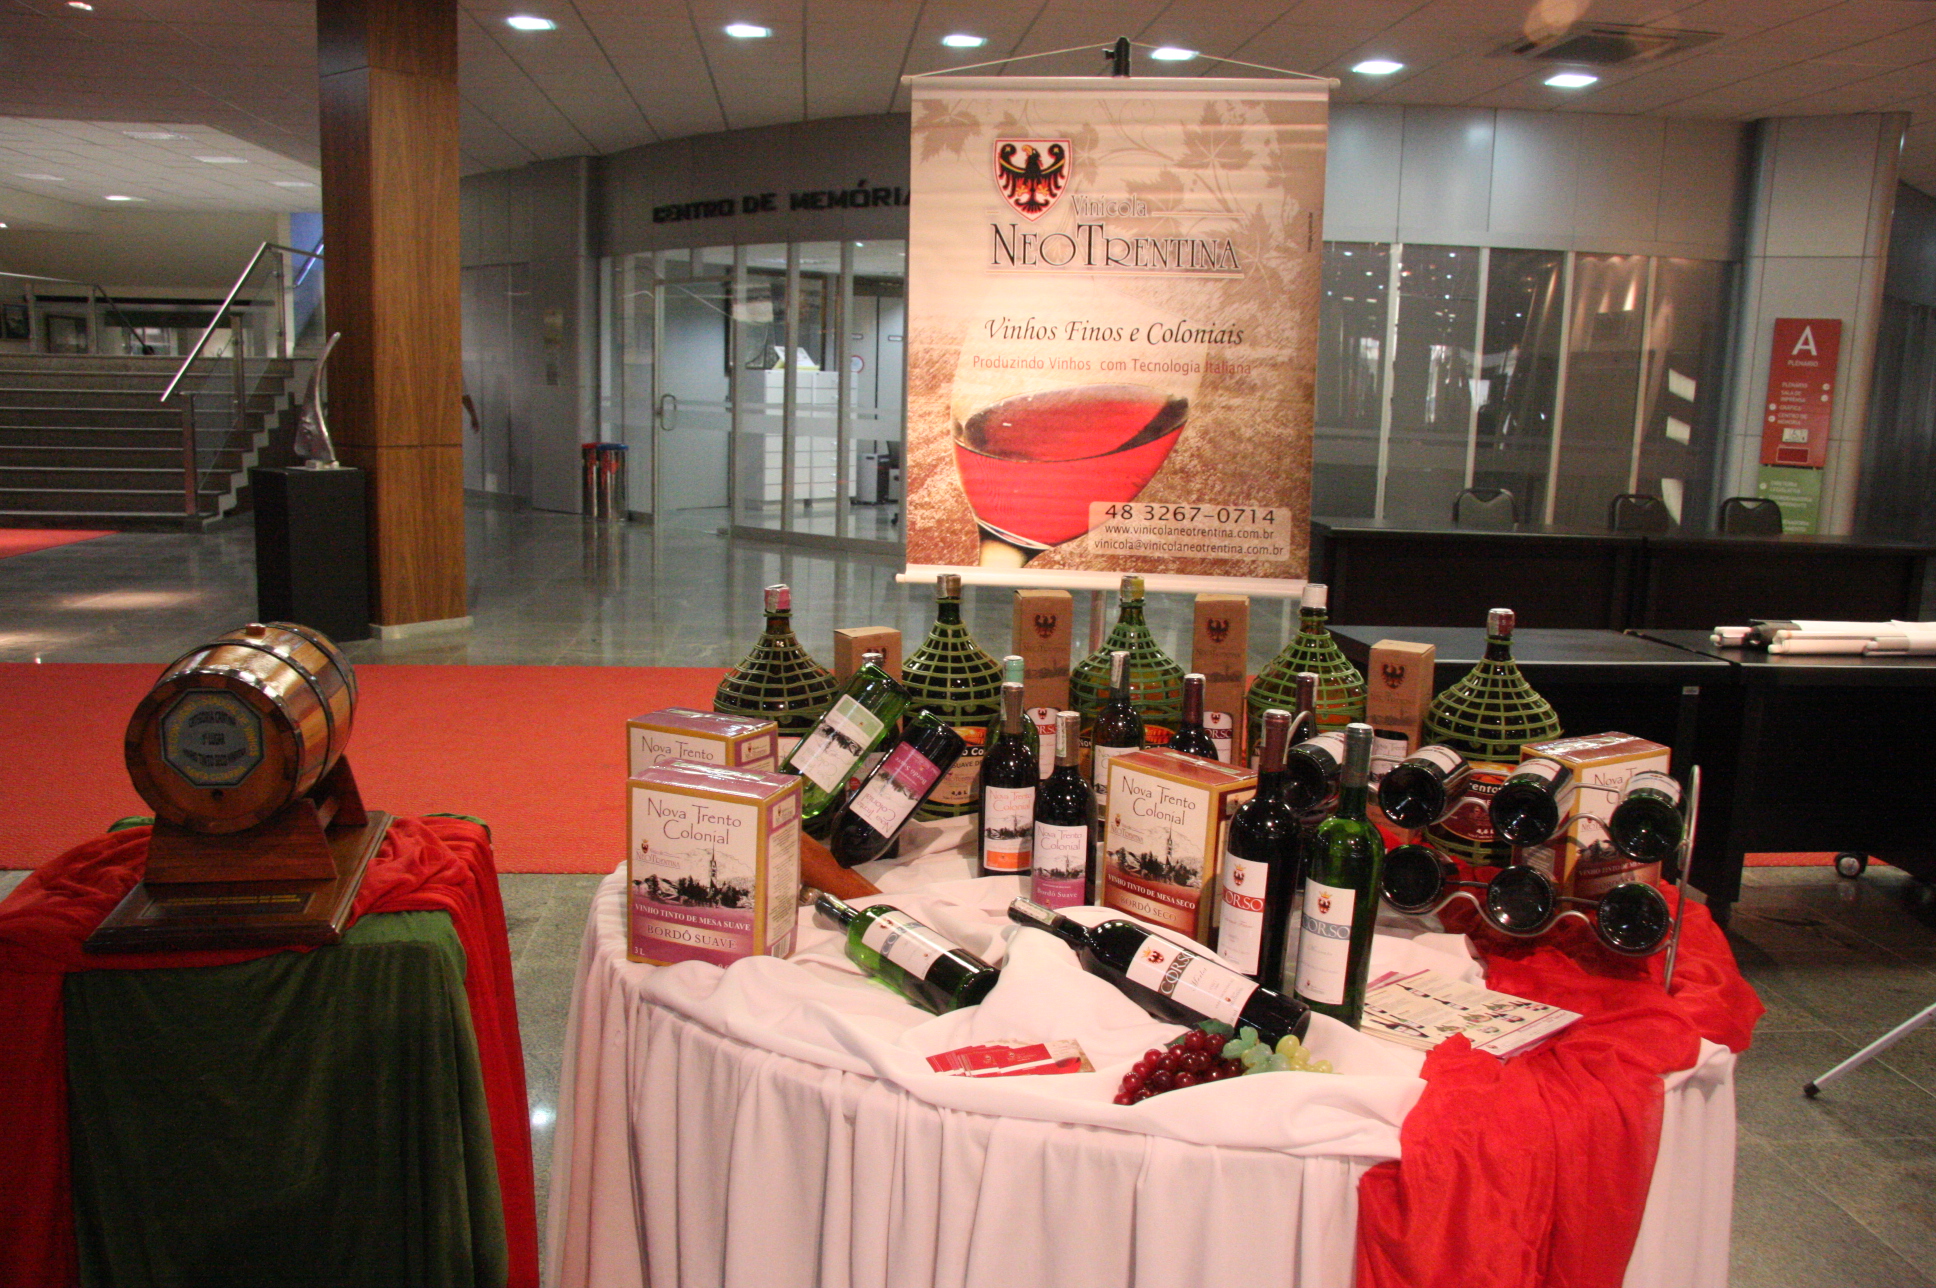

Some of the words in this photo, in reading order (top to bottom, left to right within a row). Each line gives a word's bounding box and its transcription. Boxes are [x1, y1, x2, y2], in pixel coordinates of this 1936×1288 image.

[652, 198, 736, 223] CENTRO
[742, 192, 778, 214] DE
[1070, 194, 1148, 217] Vinícola
[984, 316, 1057, 342] Vinhos
[1064, 318, 1123, 343] Finos
[1129, 325, 1140, 343] e
[1146, 319, 1245, 346] Coloniais
[1791, 325, 1818, 357] A
[972, 355, 1045, 370] Produzindo
[1049, 356, 1092, 371] Vinhos
[1100, 361, 1127, 372] com
[1131, 358, 1201, 376] Tecnologia
[1205, 360, 1251, 375] Italiana
[1104, 504, 1134, 520] 48
[1143, 505, 1276, 525] 3267-0714
[1104, 524, 1275, 540] www.vinicolaneotrentina.com.br
[1094, 539, 1285, 556] vinicola@vinicolaneotrentina.com.br
[641, 735, 672, 755] Nova
[675, 740, 714, 761] Trento
[1122, 775, 1153, 799] Nova
[1157, 785, 1196, 810] Trento
[1594, 773, 1623, 786] Nova
[648, 797, 687, 819] Nova
[692, 803, 742, 828] Trento
[992, 800, 1031, 812] Colonial
[1132, 797, 1186, 825] Colonial
[663, 819, 730, 845] Colonial
[1040, 837, 1081, 851] Colonial
[1107, 874, 1126, 887] VINHO
[1126, 881, 1146, 894] TINTO
[1146, 889, 1156, 898] DE
[1157, 891, 1176, 905] MESA
[1175, 899, 1196, 910] SECO
[634, 903, 659, 916] VINHO
[660, 908, 686, 921] TINTO
[686, 914, 698, 923] DE
[699, 916, 723, 928] MESA
[723, 920, 751, 932] SUAVE
[647, 924, 692, 942] BORDÔ
[694, 933, 738, 950] SUAVE
